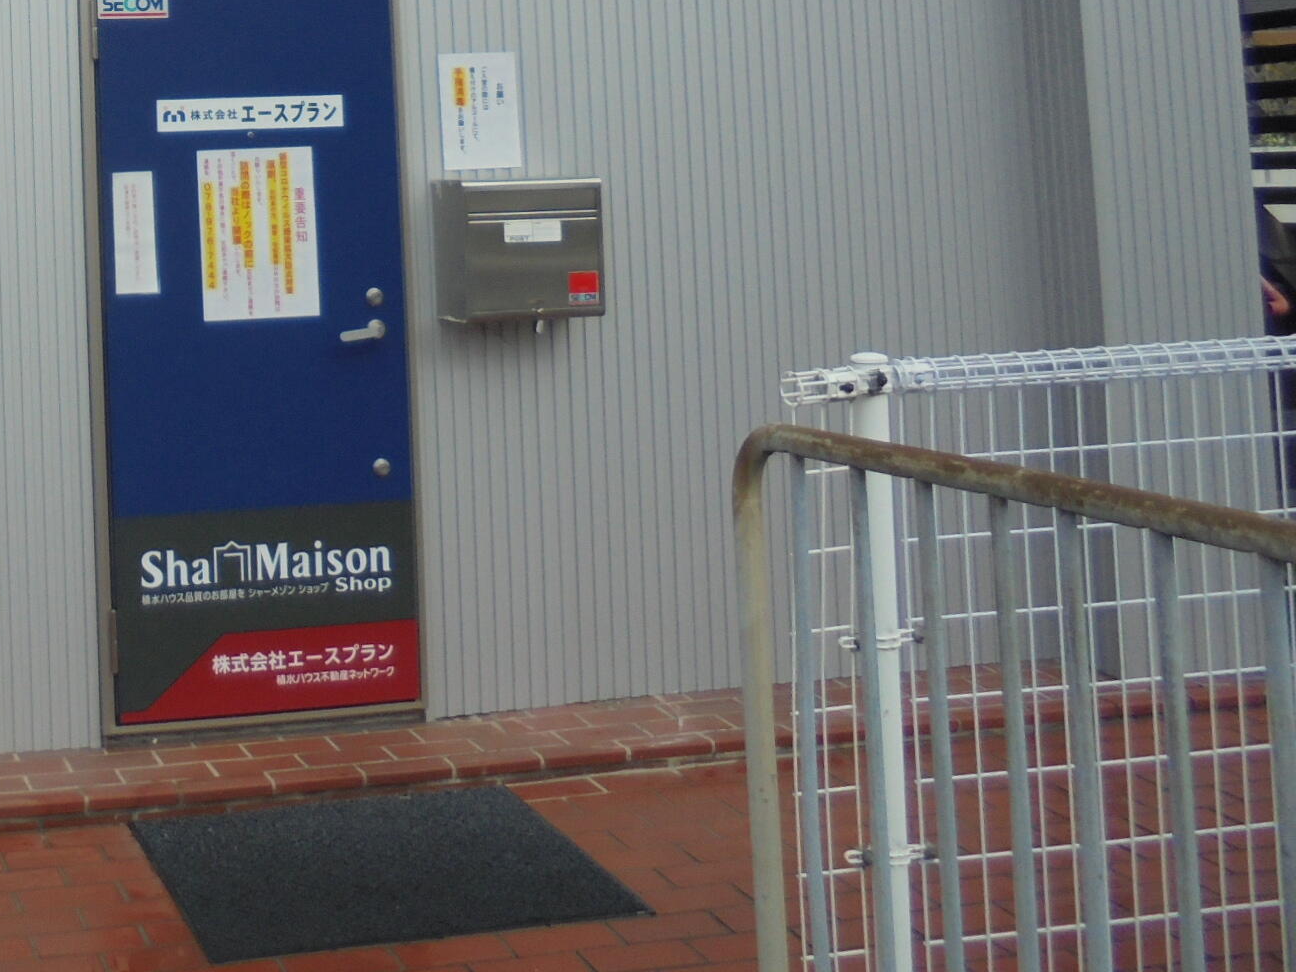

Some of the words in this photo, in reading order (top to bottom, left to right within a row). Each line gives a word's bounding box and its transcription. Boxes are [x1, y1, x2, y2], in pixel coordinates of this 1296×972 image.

[335, 575, 393, 593] Shop
[211, 643, 395, 675] 株式会社エースプラン
[276, 665, 395, 686] 積水ハウス不動産ネットワーク
